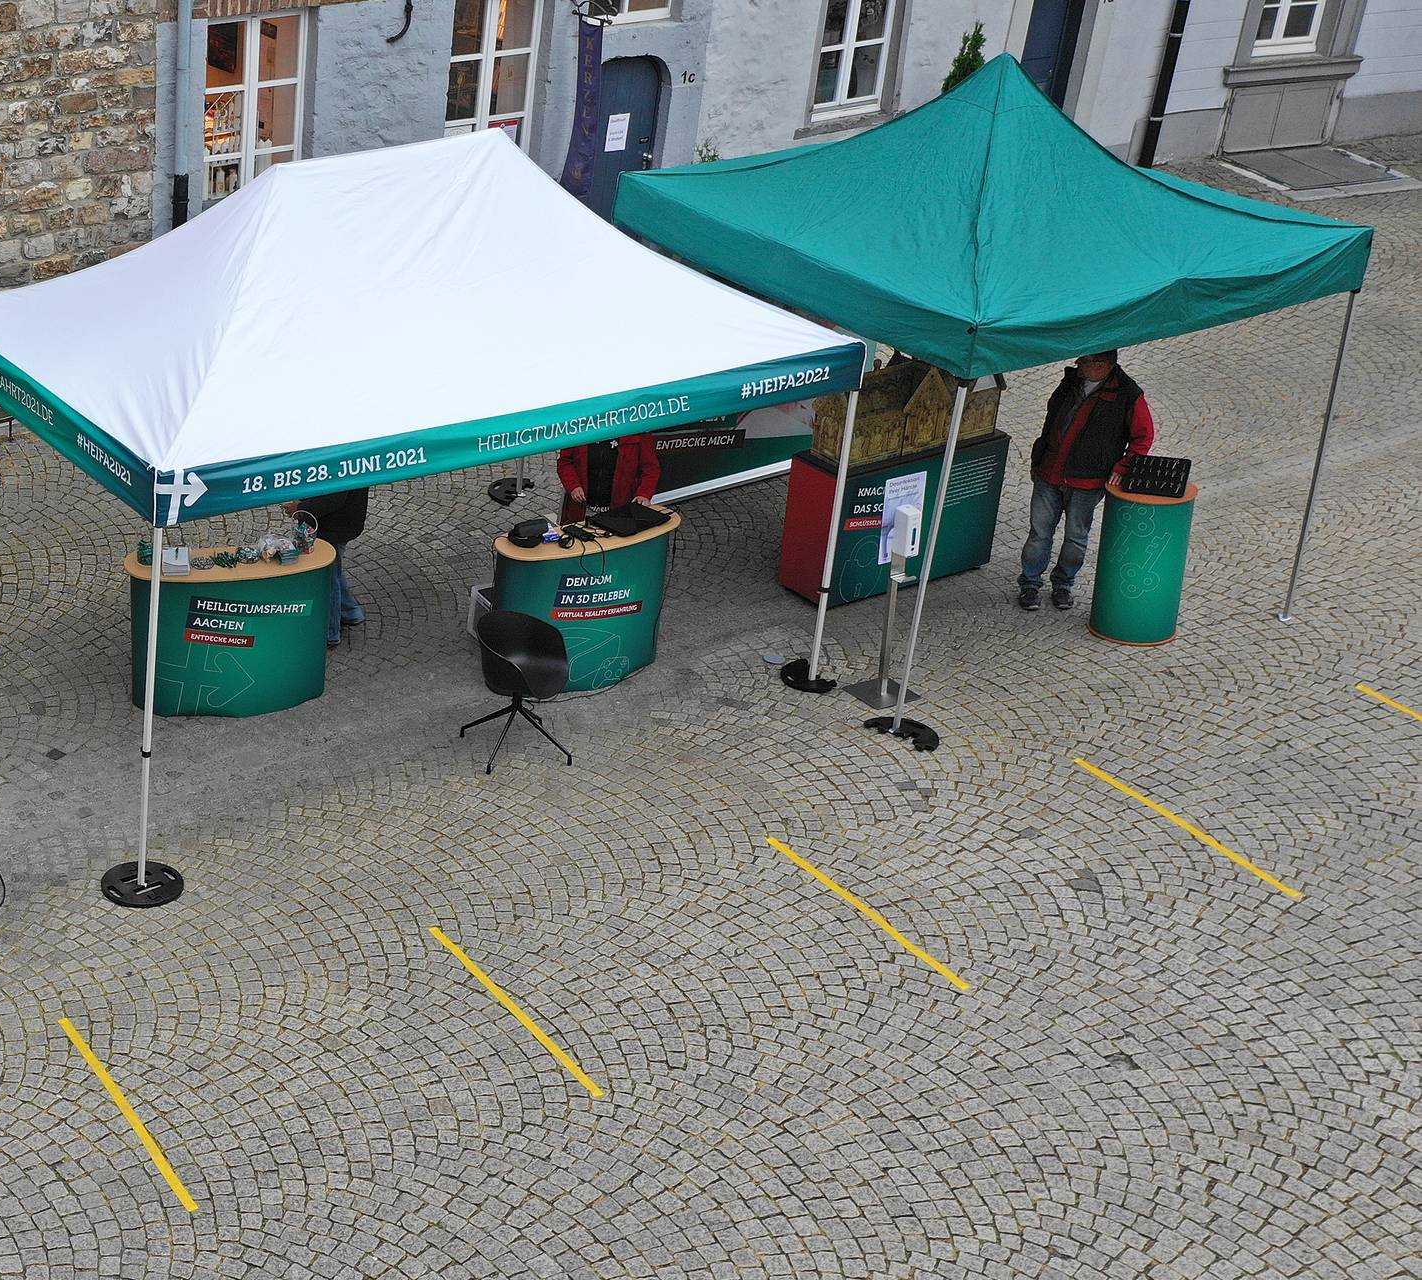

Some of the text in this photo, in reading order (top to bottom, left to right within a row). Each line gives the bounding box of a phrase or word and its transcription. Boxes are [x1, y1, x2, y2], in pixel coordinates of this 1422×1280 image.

[680, 70, 696, 84] 1c
[740, 366, 831, 400] #HEIFA2021
[477, 395, 691, 454] HEILIGTUMSFAHRT2021.DE
[656, 434, 736, 450] ENTDECKE MICH
[76, 432, 132, 486] #HEIFA2021
[242, 447, 427, 494] 18. BIS 28. JUNI 2021
[857, 486, 885, 498] KNAC
[853, 503, 884, 514] DAS SC
[566, 574, 612, 587] DEN DOM
[560, 588, 631, 604] IN 3D ERLEBEN
[197, 600, 307, 614] HEILIGTUMSFAHRT
[584, 609, 608, 618] REALITY
[193, 617, 245, 631] AACHEN
[190, 633, 248, 645] ENTDECKE MICH
